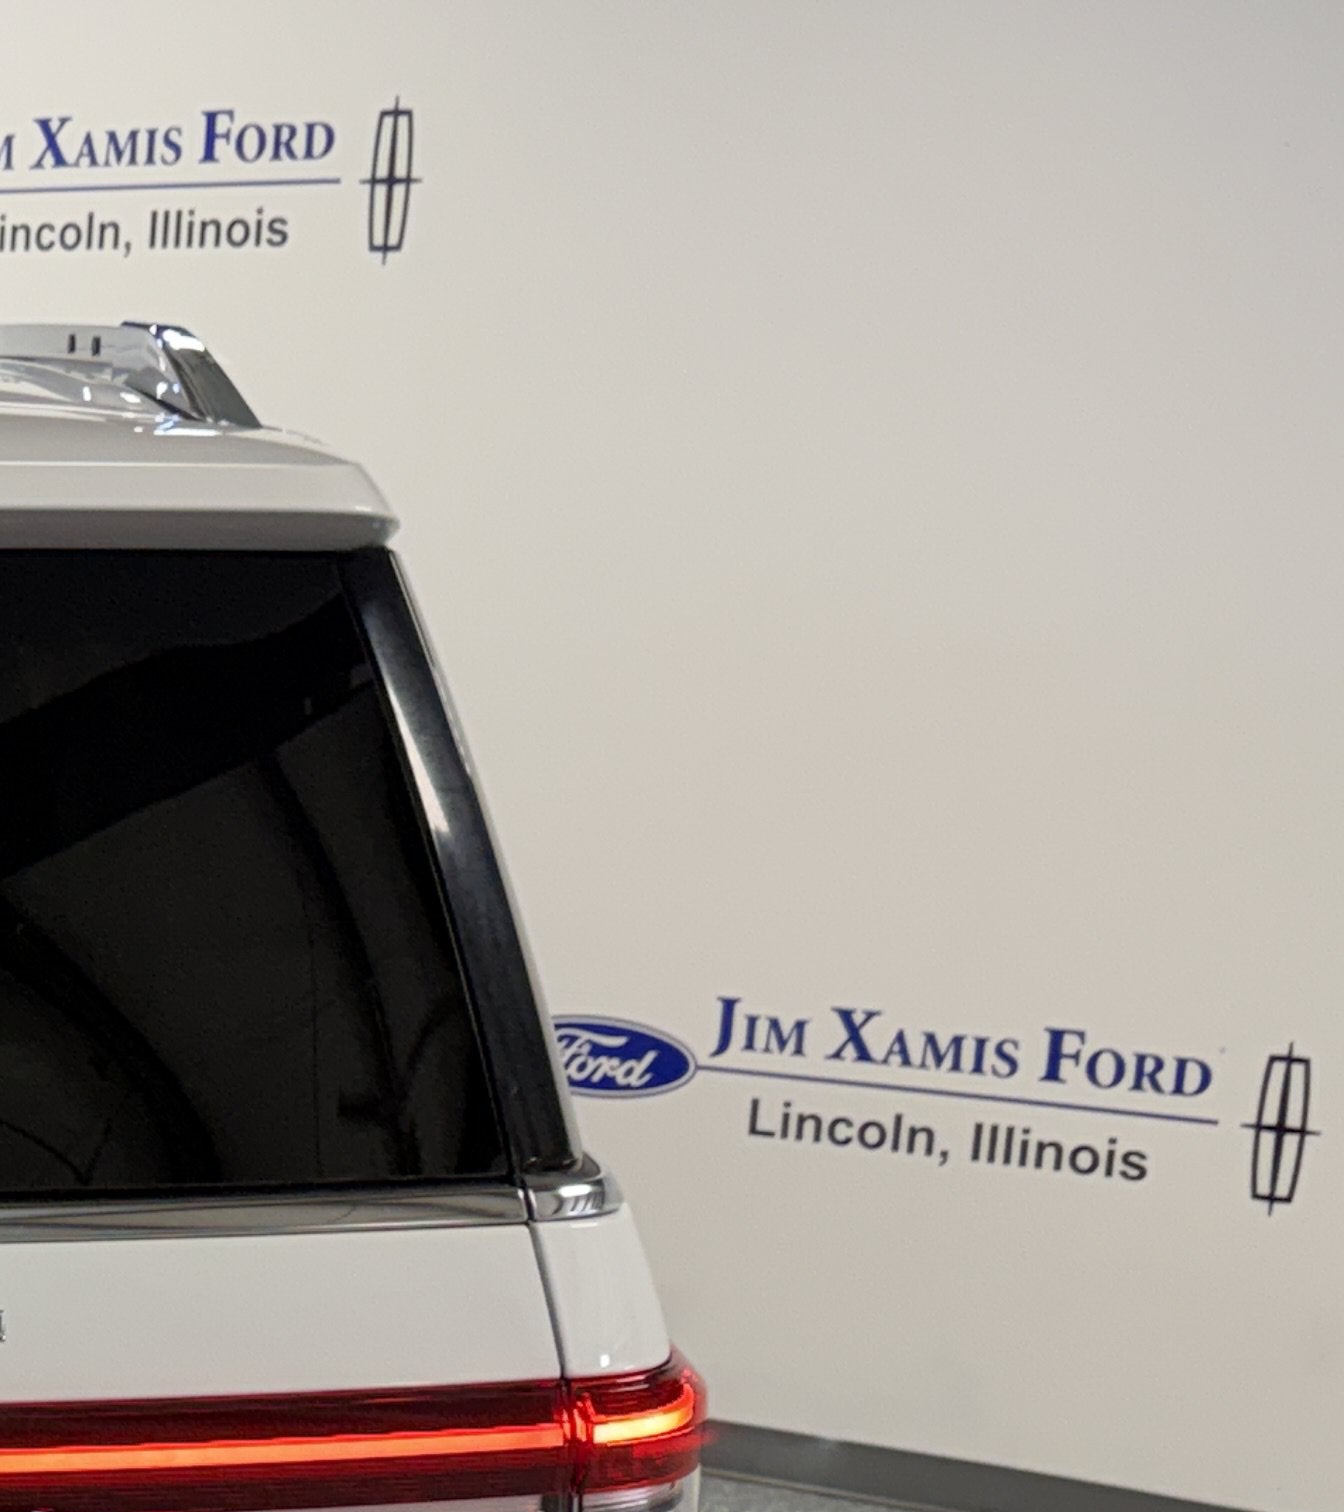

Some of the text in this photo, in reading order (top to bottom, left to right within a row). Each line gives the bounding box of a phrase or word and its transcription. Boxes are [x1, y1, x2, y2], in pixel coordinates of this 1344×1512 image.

[30, 116, 183, 170] XAMIS
[200, 109, 336, 163] FORD
[148, 208, 289, 249] Illinois
[555, 1017, 659, 1088] Ford
[710, 996, 1214, 1098] JIM XAMIS FORD
[747, 1096, 1149, 1182] Lincoln, Illinois
